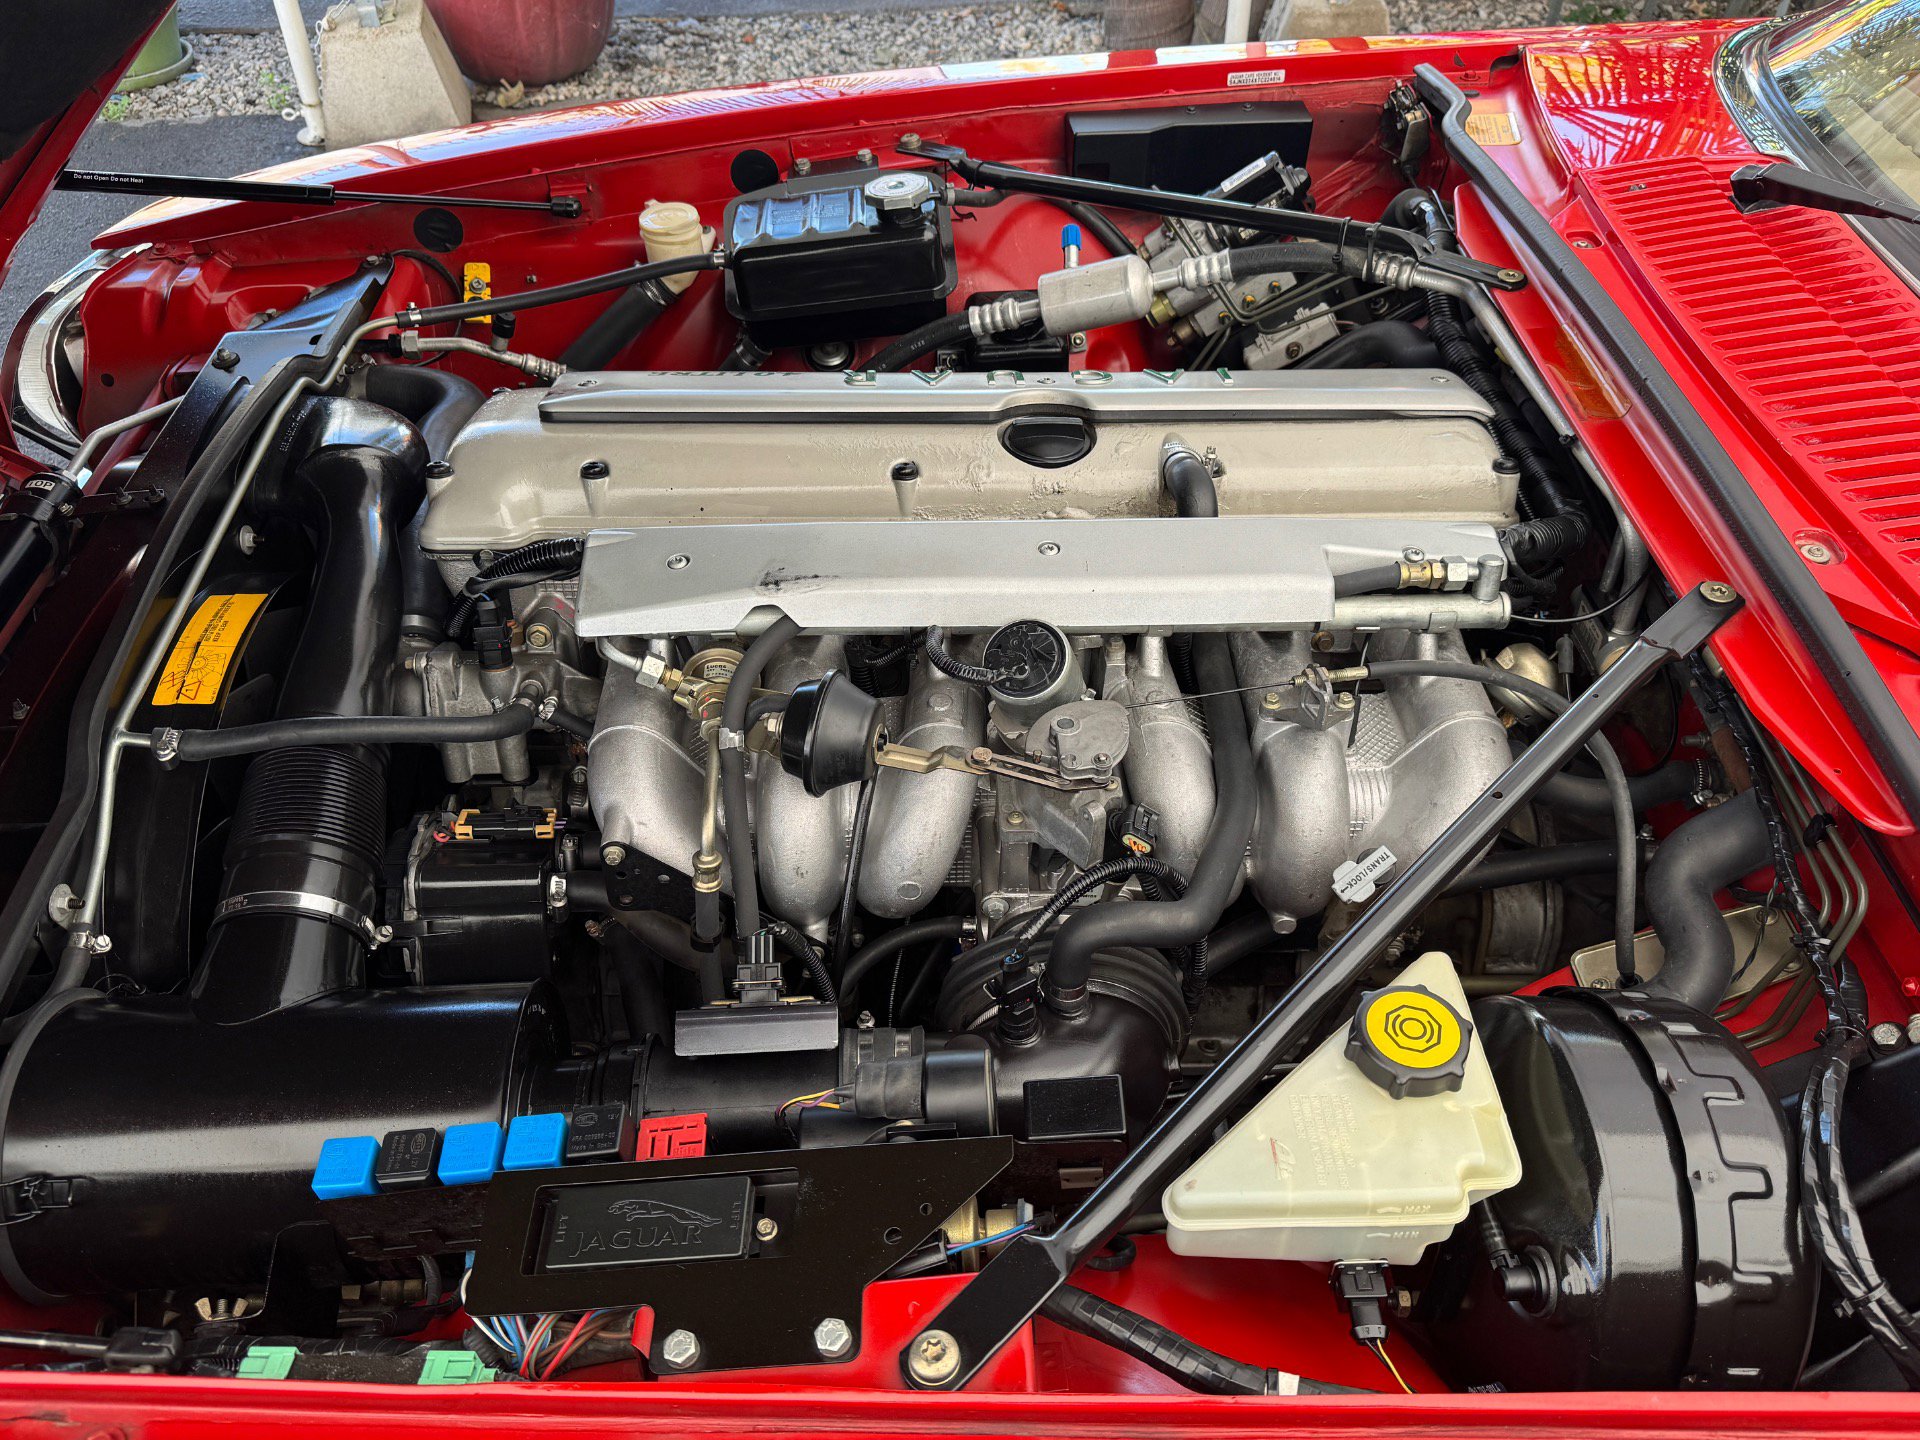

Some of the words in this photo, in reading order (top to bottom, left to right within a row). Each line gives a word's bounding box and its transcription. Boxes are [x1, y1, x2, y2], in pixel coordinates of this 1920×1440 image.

[843, 368, 1234, 386] JAGUAR
[1346, 852, 1391, 889] TRANS/LOCK
[730, 1200, 742, 1230] LIFT
[1403, 1204, 1431, 1214] MAX
[554, 1215, 568, 1243] LIFT
[568, 1225, 702, 1258] JAGUAR
[1392, 1231, 1420, 1240] MIN
